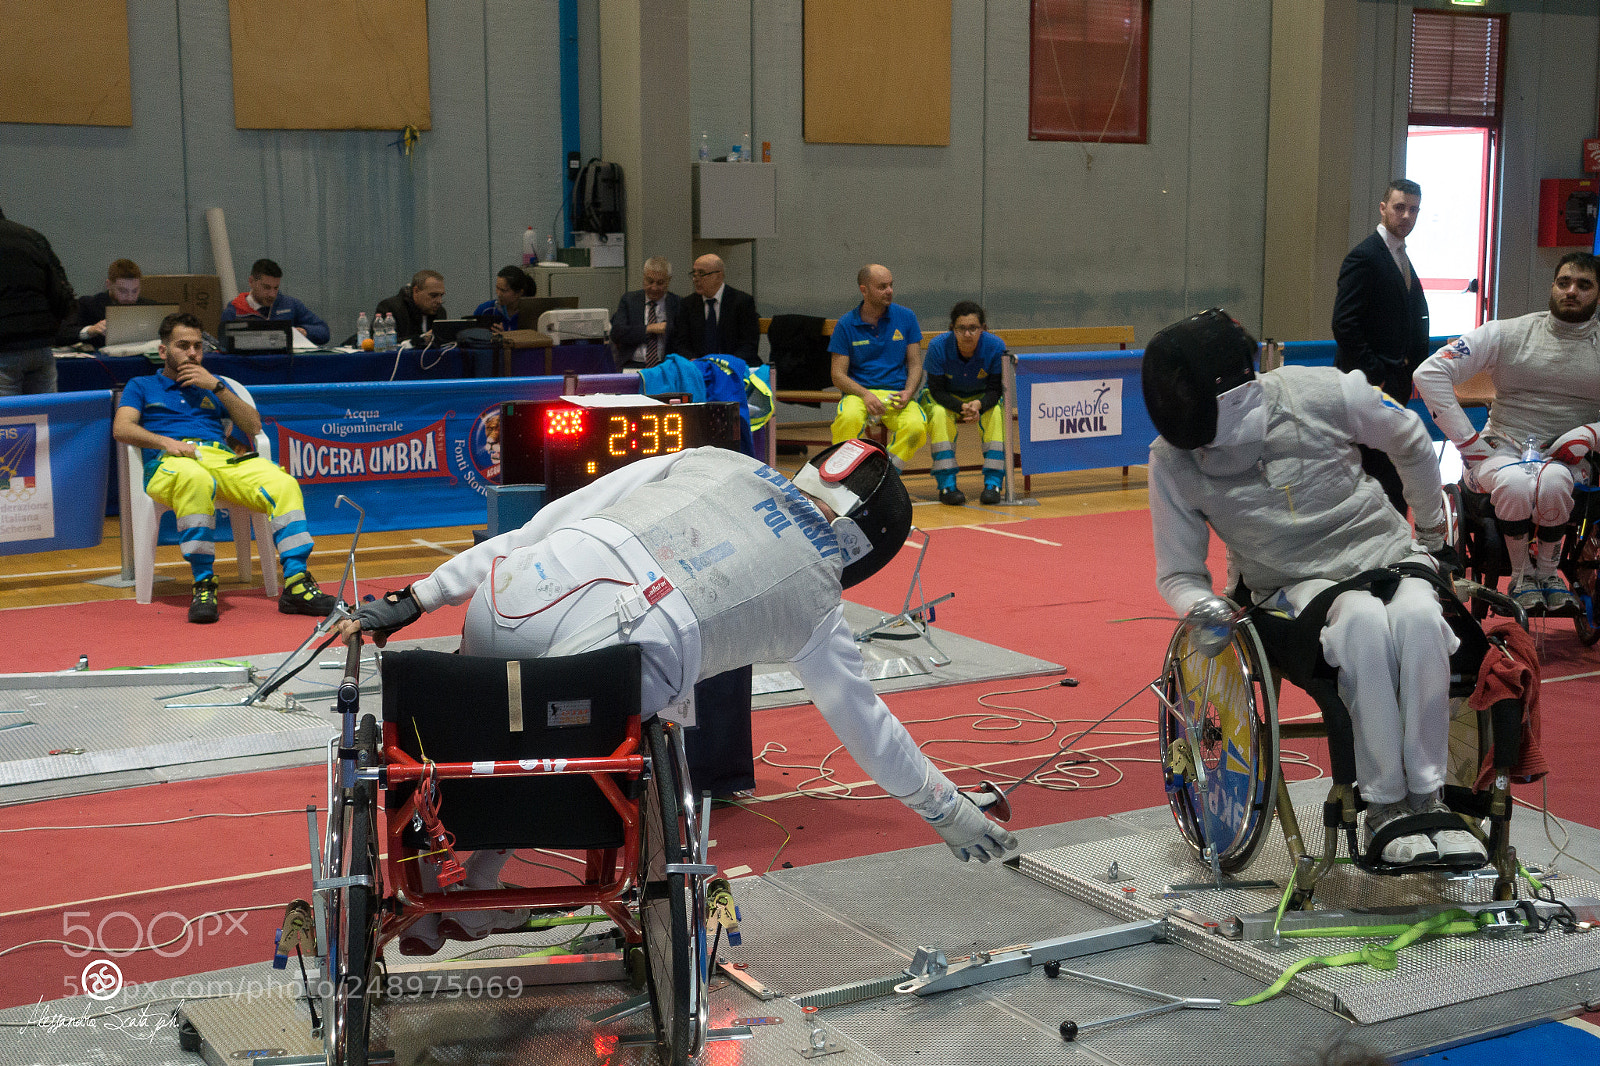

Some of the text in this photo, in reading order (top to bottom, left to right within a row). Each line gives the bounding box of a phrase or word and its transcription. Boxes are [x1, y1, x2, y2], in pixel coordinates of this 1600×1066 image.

[344, 408, 380, 422] Acqua
[1038, 399, 1110, 422] SuperAbile
[321, 421, 404, 438] Oligominerale
[608, 413, 683, 456] 2:39
[288, 436, 365, 477] NOCERA
[368, 431, 438, 474] UMBRA
[454, 439, 470, 471] Fonti
[751, 497, 793, 539] POL
